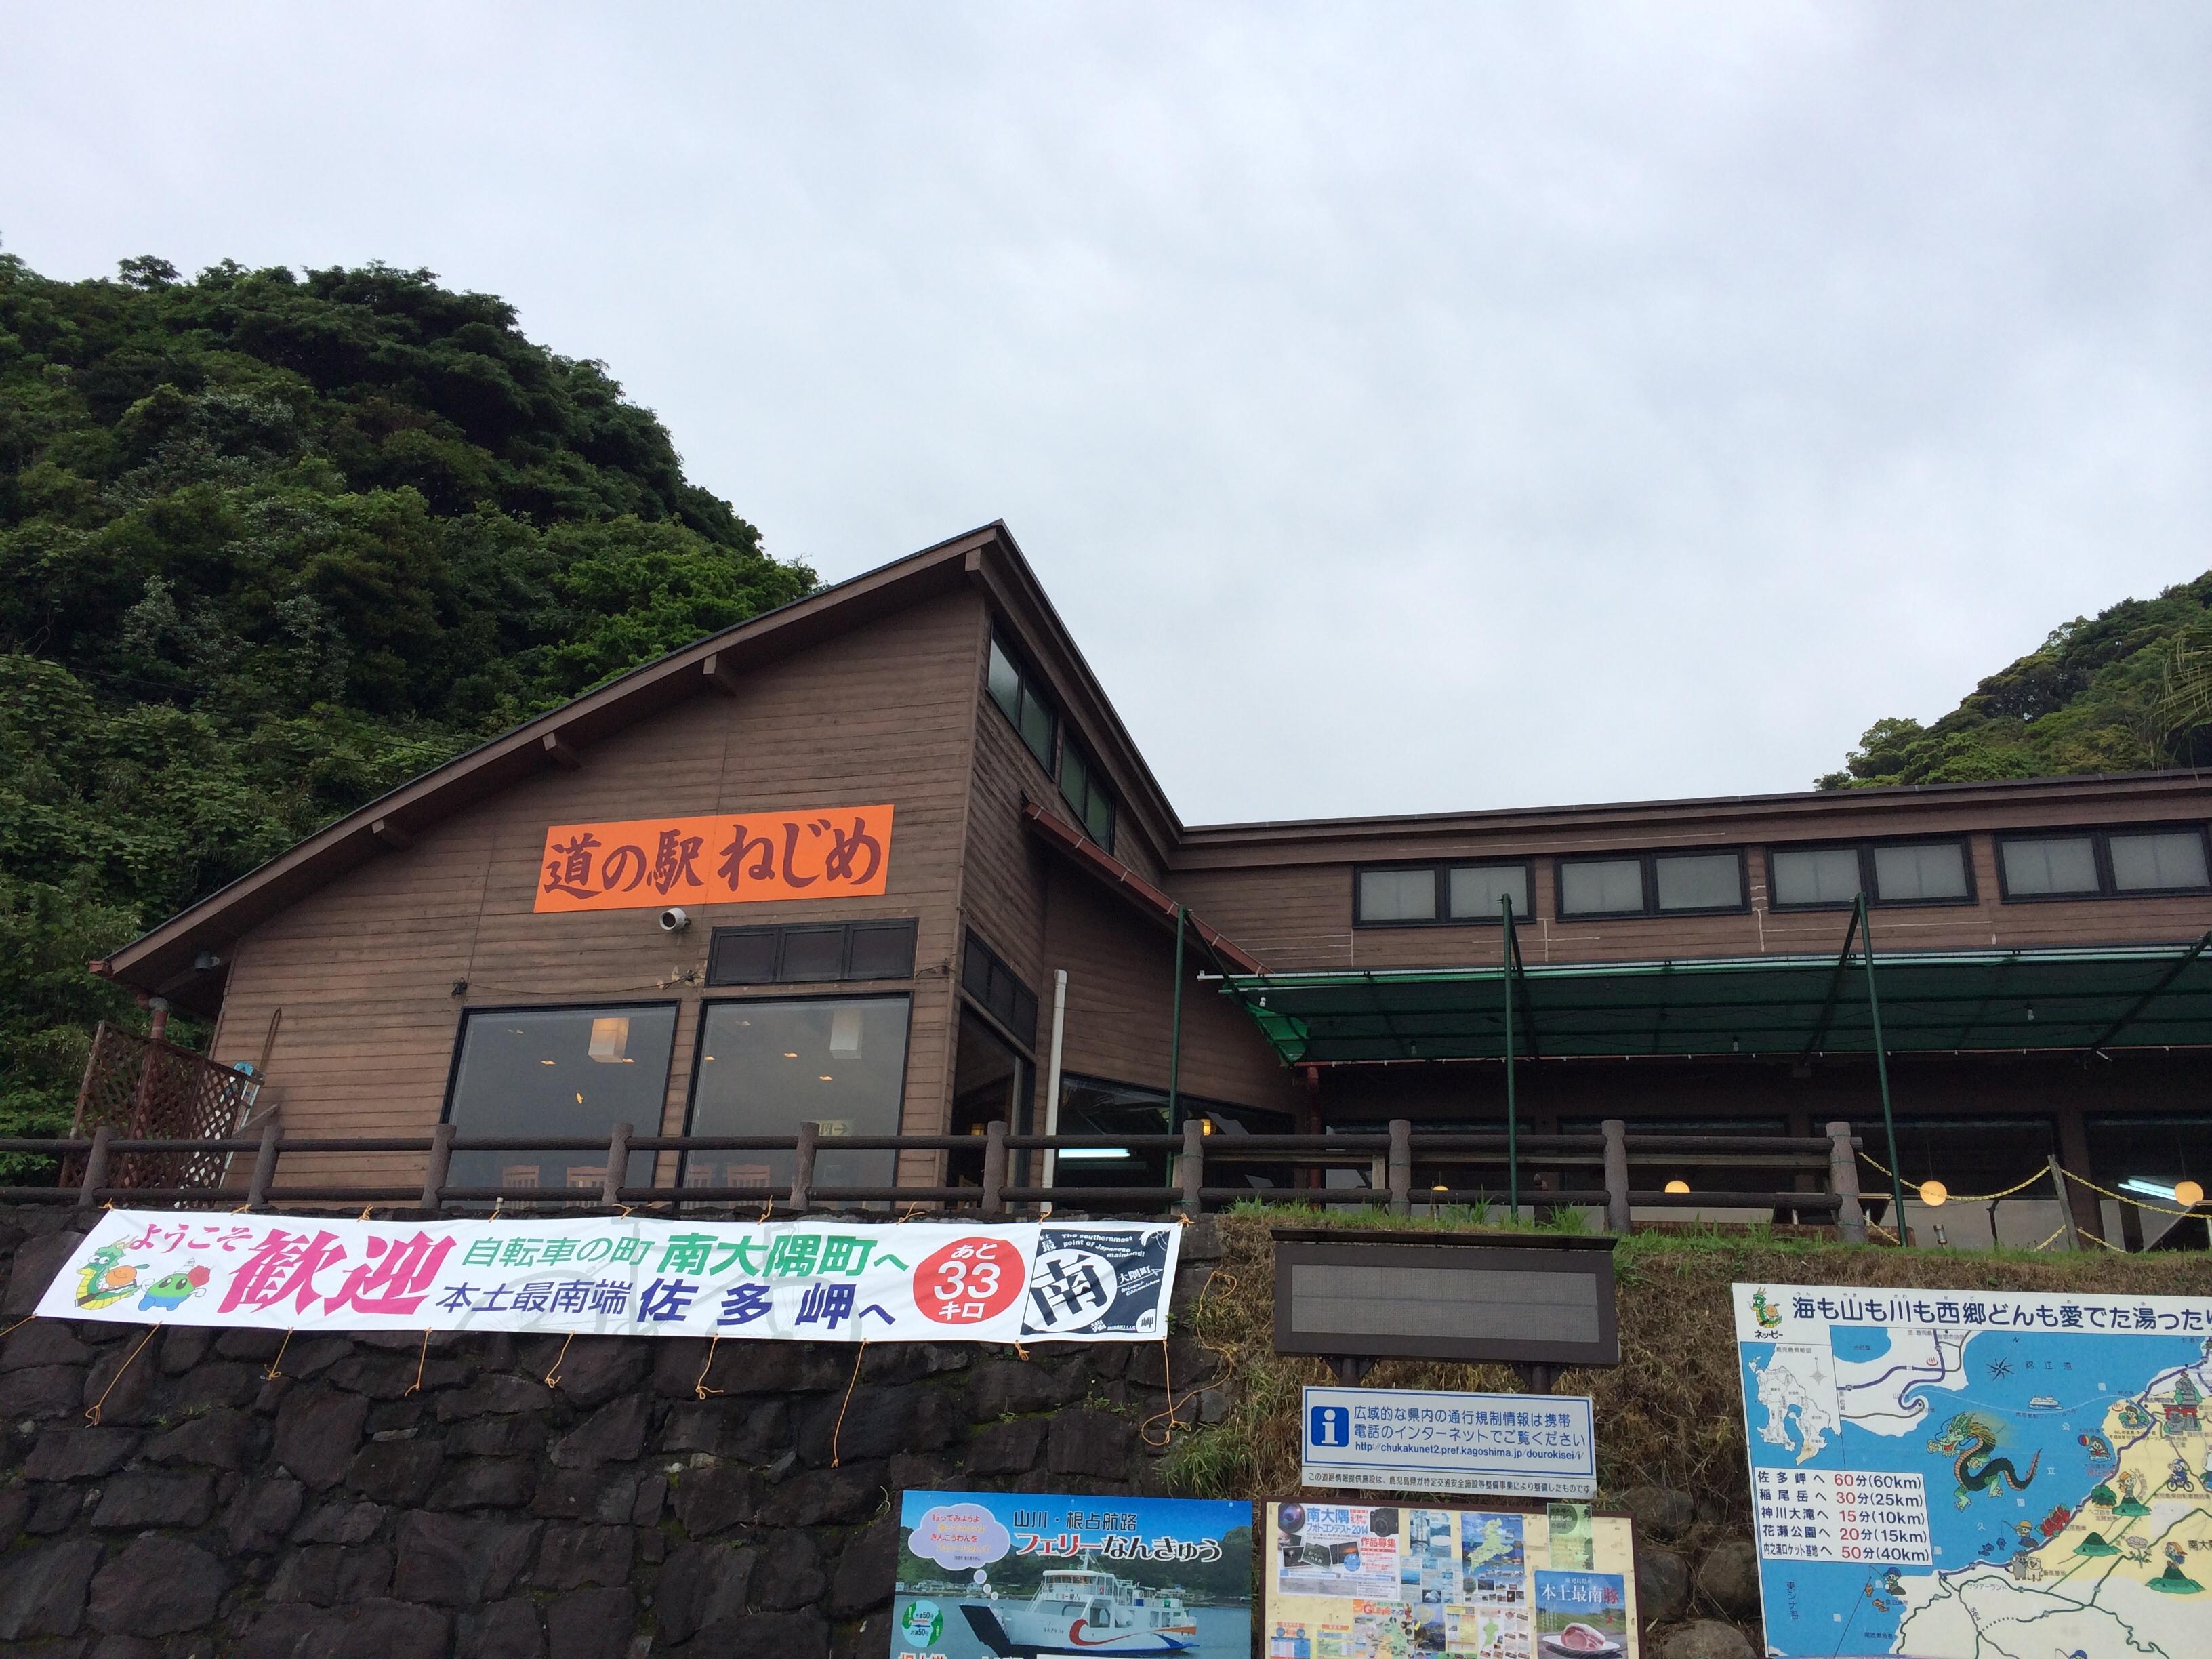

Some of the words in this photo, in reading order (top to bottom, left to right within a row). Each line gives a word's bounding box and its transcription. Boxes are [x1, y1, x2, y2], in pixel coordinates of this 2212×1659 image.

[544, 829, 705, 900] 道の駅
[717, 817, 882, 892] ねじめ
[129, 1223, 253, 1254] ようこそ
[1063, 1239, 1084, 1248] point
[462, 1235, 657, 1267] 自転車の町
[655, 1232, 910, 1278] 南大隅町へ
[951, 1243, 998, 1260] あと
[217, 1228, 457, 1317] 歓迎
[934, 1260, 1001, 1300] 33
[1029, 1254, 1107, 1326] 南
[435, 1279, 634, 1315] 本土最南端
[636, 1277, 896, 1330] 佐多岬へ
[938, 1301, 985, 1320] キロ
[1354, 1406, 1570, 1429] 広域的な県内の通行規制情報は携帯
[1354, 1424, 1585, 1447] 電話のインターネットでご覧ください
[1758, 1471, 1825, 1484] 佐多岬へ
[1834, 1474, 1921, 1489] 60分(60km)
[1760, 1489, 1826, 1502] 稲尾岳へ
[1837, 1492, 1923, 1507] 30分(25km)
[1014, 1509, 1138, 1532] 山川・根占航路
[1307, 1507, 1349, 1523] 南大隅
[1762, 1507, 1828, 1520] 神川大滝へ
[1839, 1510, 1925, 1525] 15分(10km)
[1307, 1523, 1368, 1534] フォトコンテスト2014
[1763, 1525, 1830, 1538] 花瀬公園へ
[1839, 1528, 1927, 1543] 20分(15km)
[1015, 1532, 1222, 1563] フェリーなんきゅう
[1360, 1537, 1396, 1548] 作品募集
[1841, 1546, 1929, 1561] 50分(40km)
